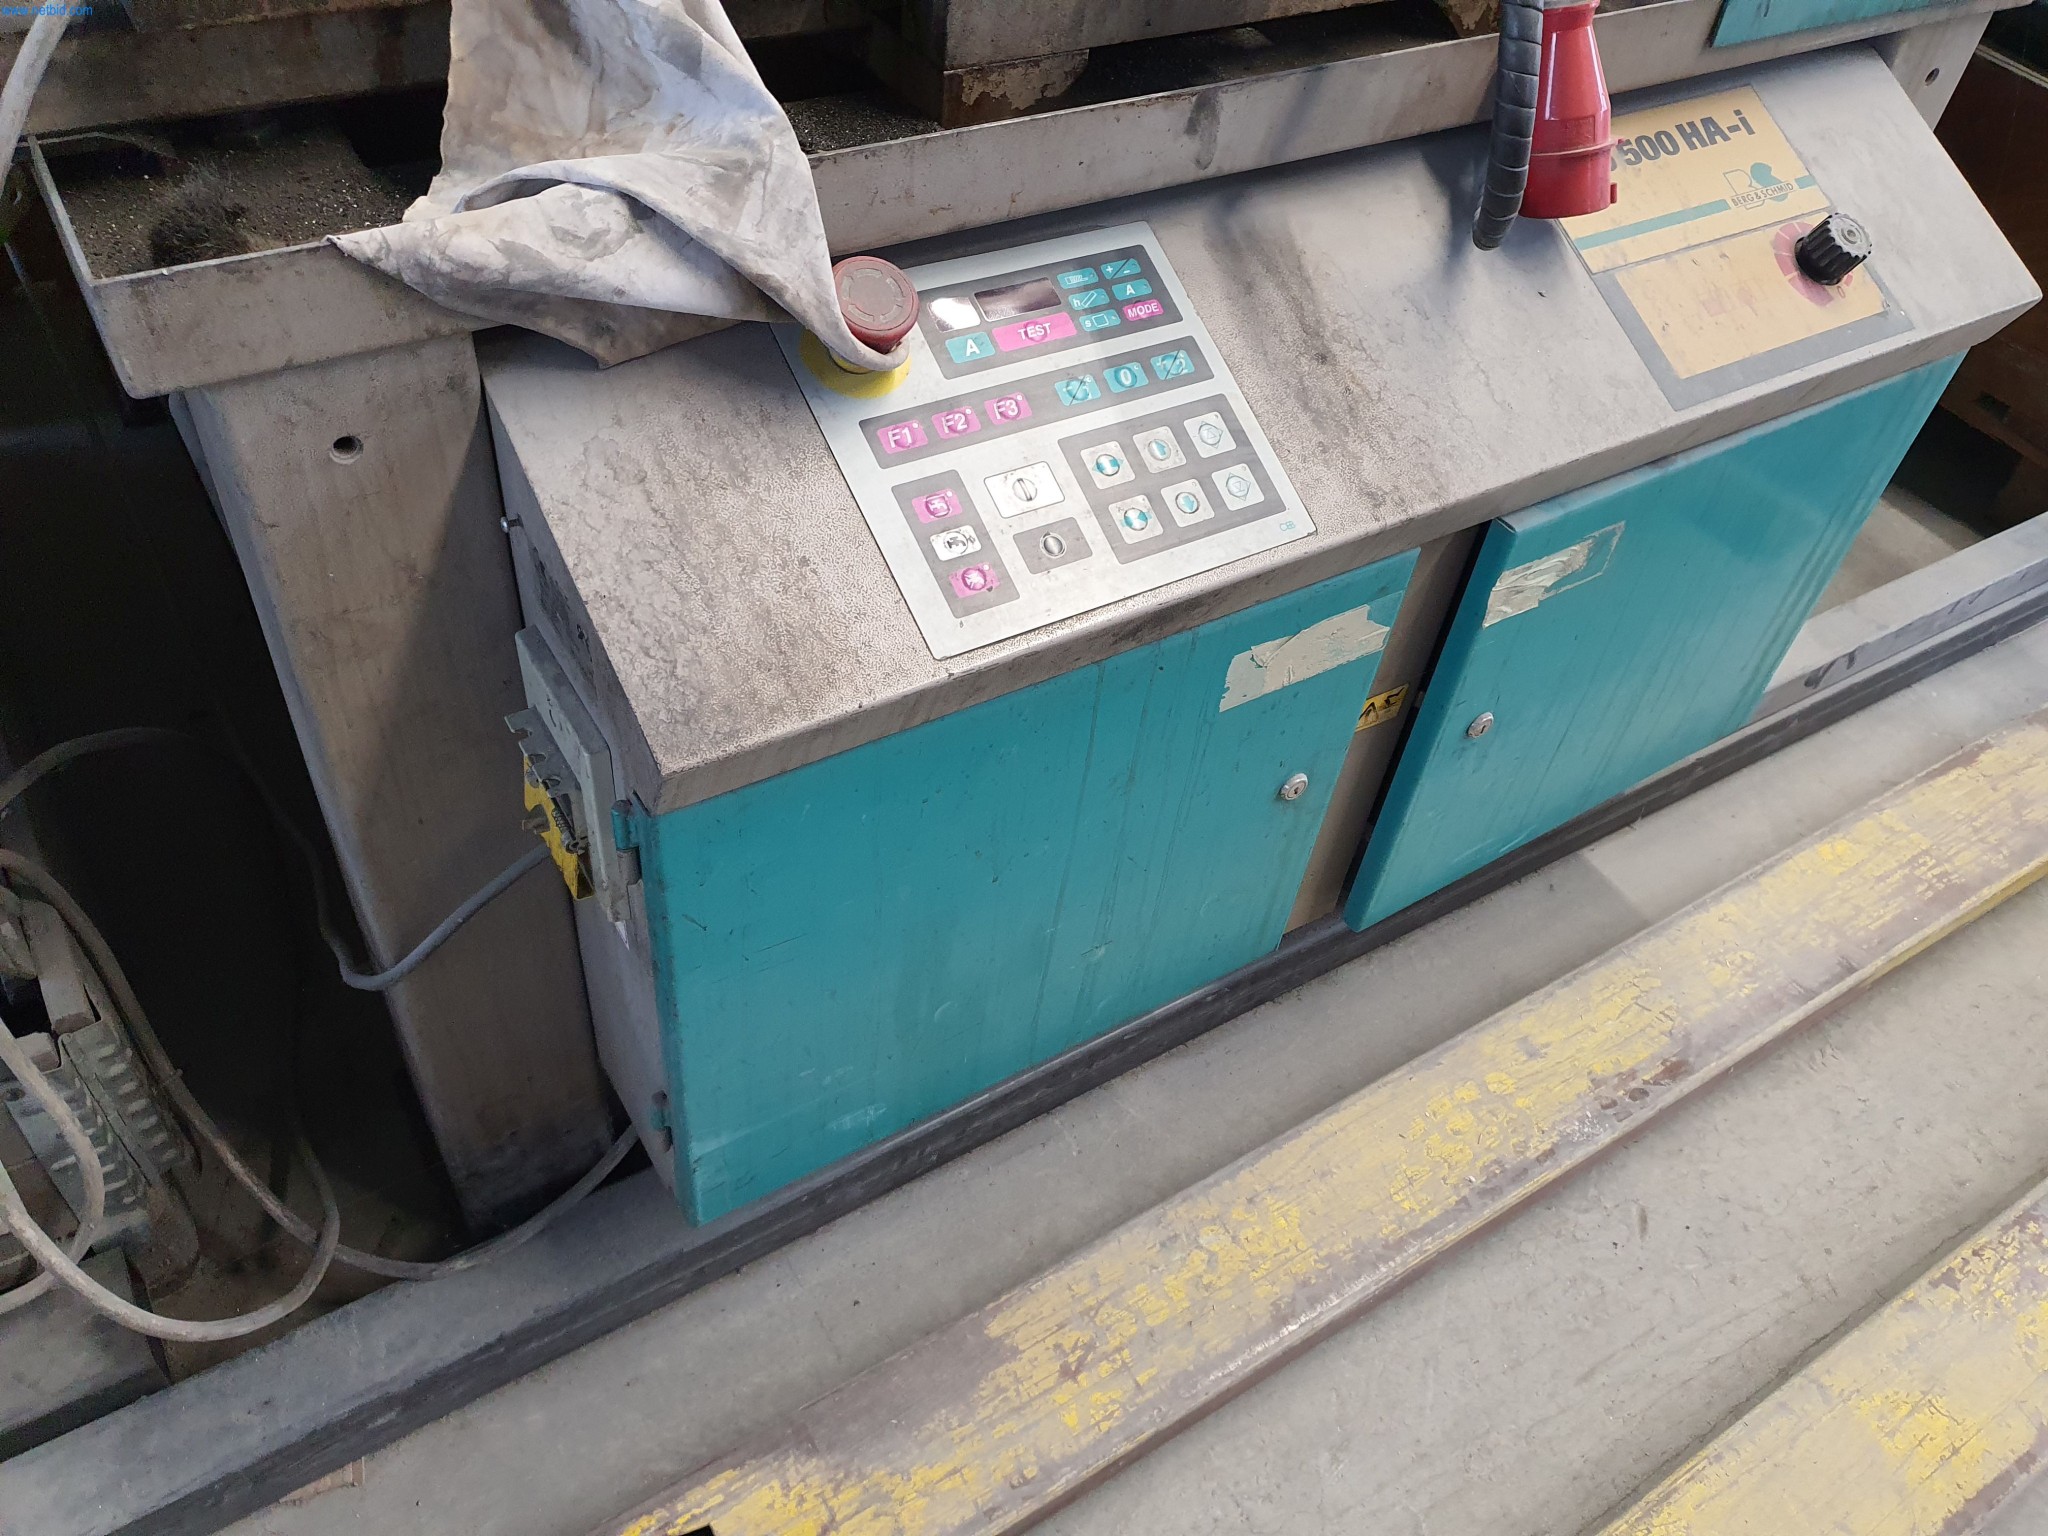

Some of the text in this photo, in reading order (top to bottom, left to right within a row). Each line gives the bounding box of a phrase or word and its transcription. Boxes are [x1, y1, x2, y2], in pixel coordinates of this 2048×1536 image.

[1616, 130, 1680, 166] 500
[1675, 109, 1756, 151] HA-i
[1731, 193, 1755, 206] BERG
[1761, 182, 1794, 199] SCHMID
[1126, 284, 1136, 296] A
[1127, 302, 1159, 318] MODE
[1017, 322, 1051, 340] TEST
[965, 338, 981, 357] A
[887, 399, 1019, 449] F1 F2 F3
